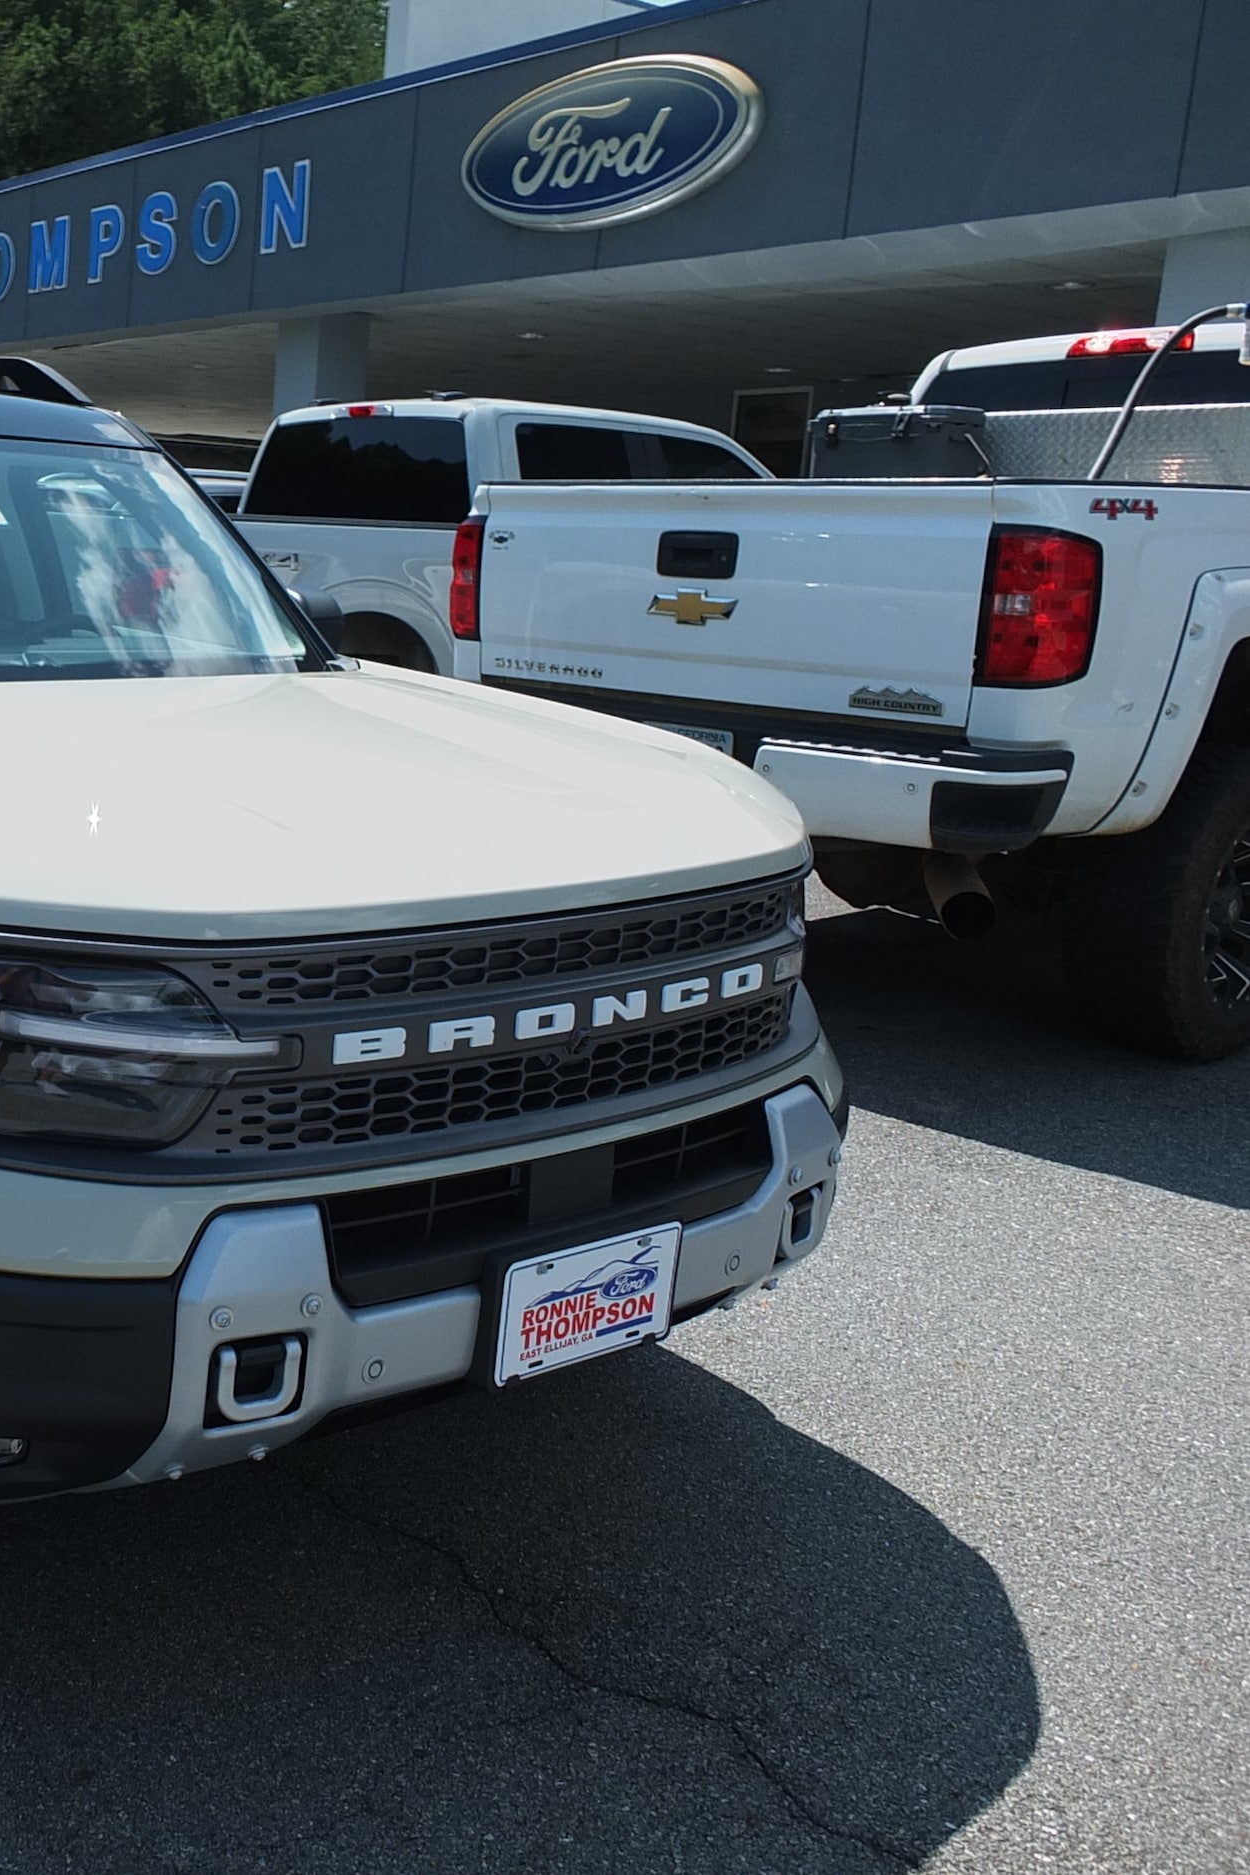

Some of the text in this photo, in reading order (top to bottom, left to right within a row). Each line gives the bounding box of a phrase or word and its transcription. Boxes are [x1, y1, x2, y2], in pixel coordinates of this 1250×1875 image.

[511, 97, 672, 195] Ford
[493, 655, 603, 679] SILVERADO
[852, 697, 939, 712] HIGH COUNTRY
[331, 961, 764, 1065] BRONCO
[609, 1271, 647, 1295] Ford
[519, 1292, 655, 1350] THOMPSON
[522, 1291, 598, 1329] RONNIE
[519, 1332, 594, 1361] EAST ELLIJAY, GA
